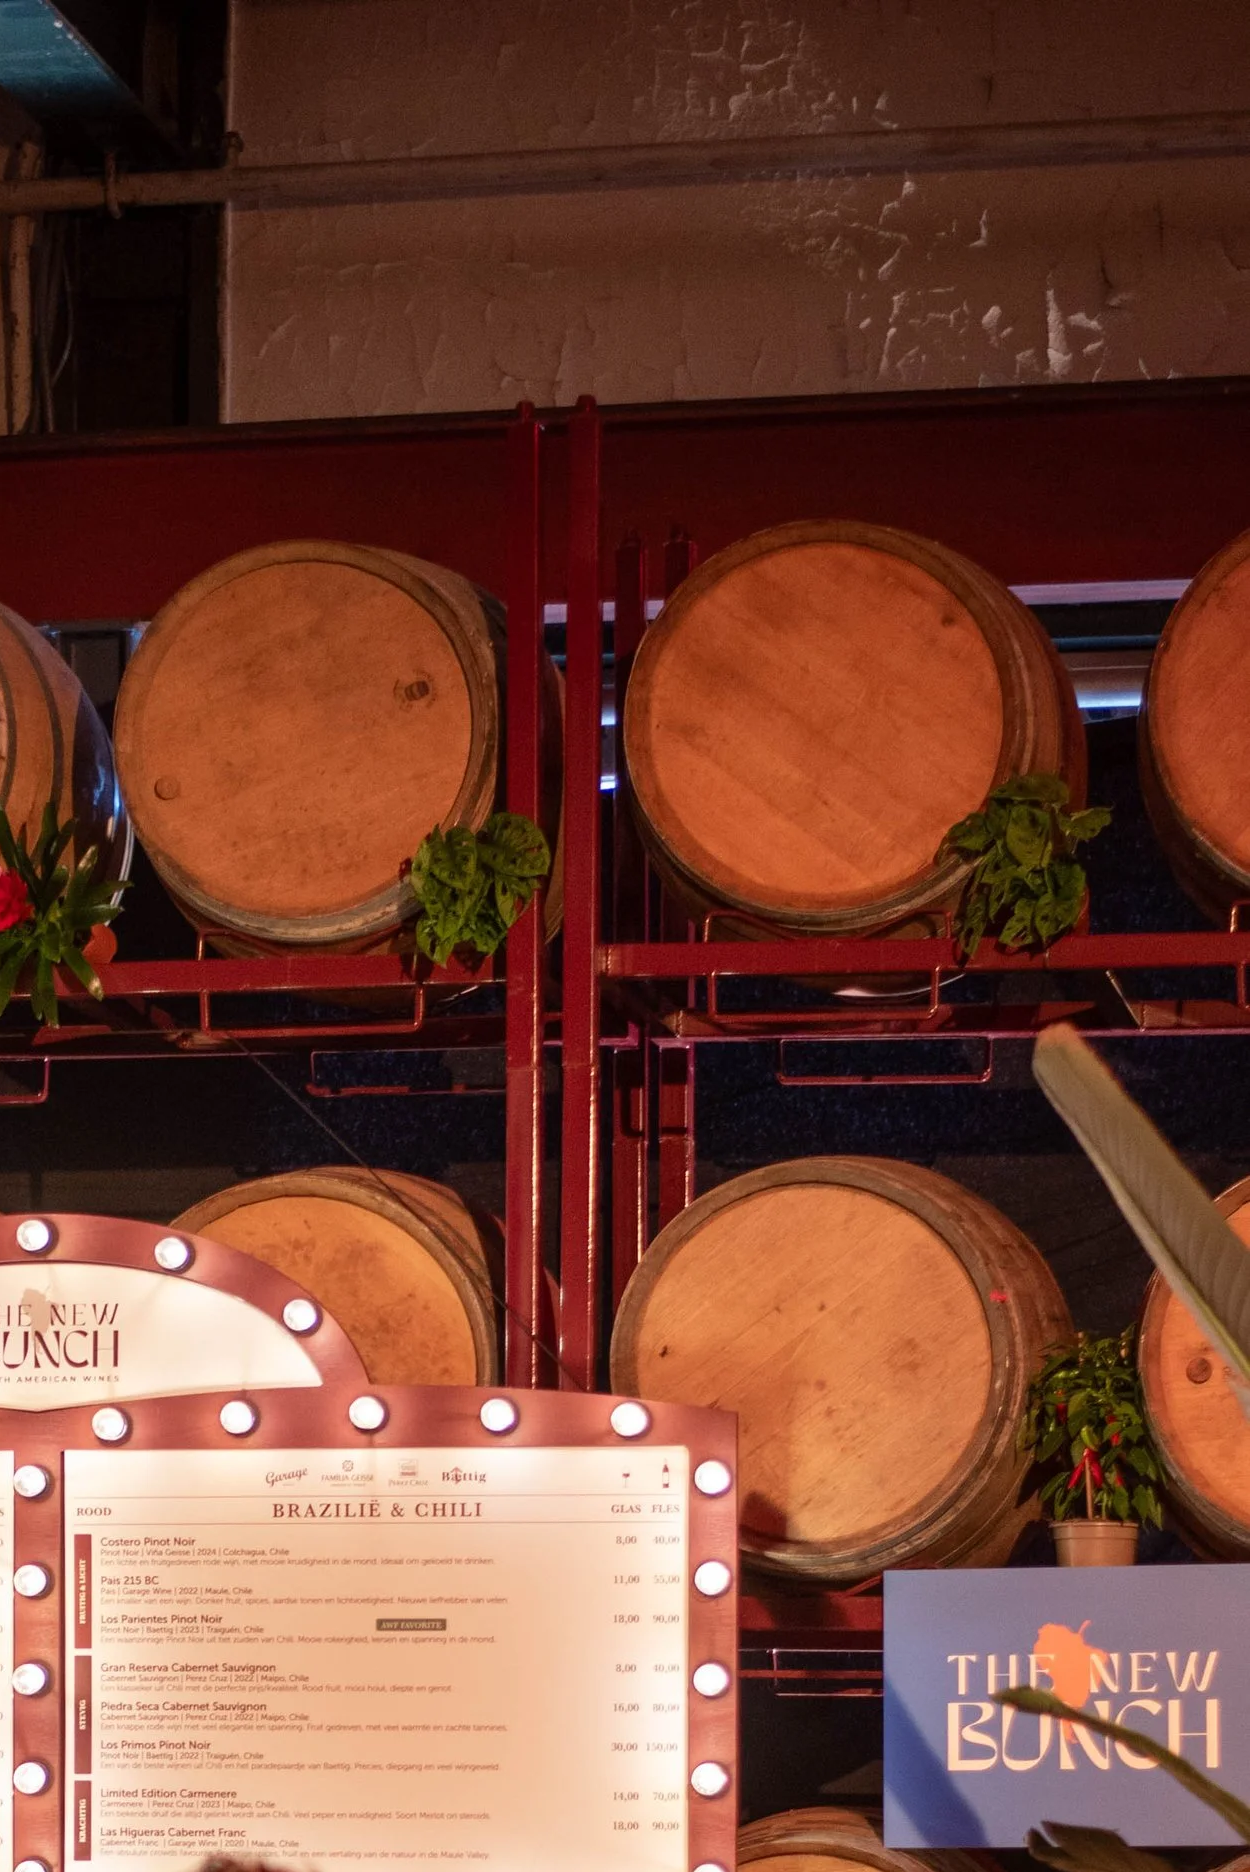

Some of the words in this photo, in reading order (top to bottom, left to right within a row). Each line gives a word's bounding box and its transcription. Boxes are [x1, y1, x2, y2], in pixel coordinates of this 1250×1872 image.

[51, 1303, 119, 1326] NEW
[265, 1467, 308, 1487] Garage
[76, 1507, 112, 1516] ROOD
[272, 1500, 381, 1518] BRAZILIË
[390, 1503, 405, 1517] &
[415, 1502, 482, 1517] CHILI
[611, 1505, 642, 1513] GLAS
[651, 1504, 680, 1513] FLES
[101, 1537, 141, 1546] Costero
[144, 1537, 170, 1546] Pinot
[174, 1537, 196, 1546] Noir
[616, 1536, 637, 1545] 8,00
[124, 1576, 141, 1585] 215
[145, 1576, 159, 1585] BC
[614, 1576, 640, 1585] 11,00
[122, 1587, 151, 1596] Garage
[153, 1587, 171, 1595] Wine
[101, 1615, 118, 1624] Los
[121, 1615, 168, 1624] Parientes
[171, 1615, 197, 1624] Pinot
[200, 1615, 223, 1623] Noir
[613, 1615, 639, 1624] 18,00
[101, 1663, 125, 1672] Gran
[129, 1663, 168, 1672] Reserva
[171, 1663, 219, 1672] Cabernet
[221, 1663, 276, 1674] Sauvignon
[616, 1664, 636, 1672] 8,00
[1090, 1650, 1218, 1693] NEW
[101, 1702, 133, 1711] Piedra
[136, 1702, 159, 1711] Seca
[162, 1702, 209, 1711] Cabernet
[212, 1702, 267, 1713] Sauvignon
[613, 1704, 639, 1712] 16,00
[947, 1699, 1219, 1772] BUNCH
[101, 1740, 118, 1750] Los
[121, 1740, 156, 1750] Primos
[159, 1740, 185, 1750] Pinot
[189, 1740, 211, 1749] Noir
[611, 1743, 638, 1752] 30,00
[101, 1789, 138, 1798] Limited
[141, 1789, 177, 1798] Edition
[180, 1789, 237, 1798] Carmenere
[613, 1792, 639, 1801] 14,00
[613, 1822, 639, 1830] 18,00
[652, 1822, 679, 1830] 90,00
[101, 1828, 117, 1837] Las
[120, 1828, 166, 1839] Higueras
[168, 1828, 215, 1837] Cabernet
[219, 1828, 246, 1837] Franc
